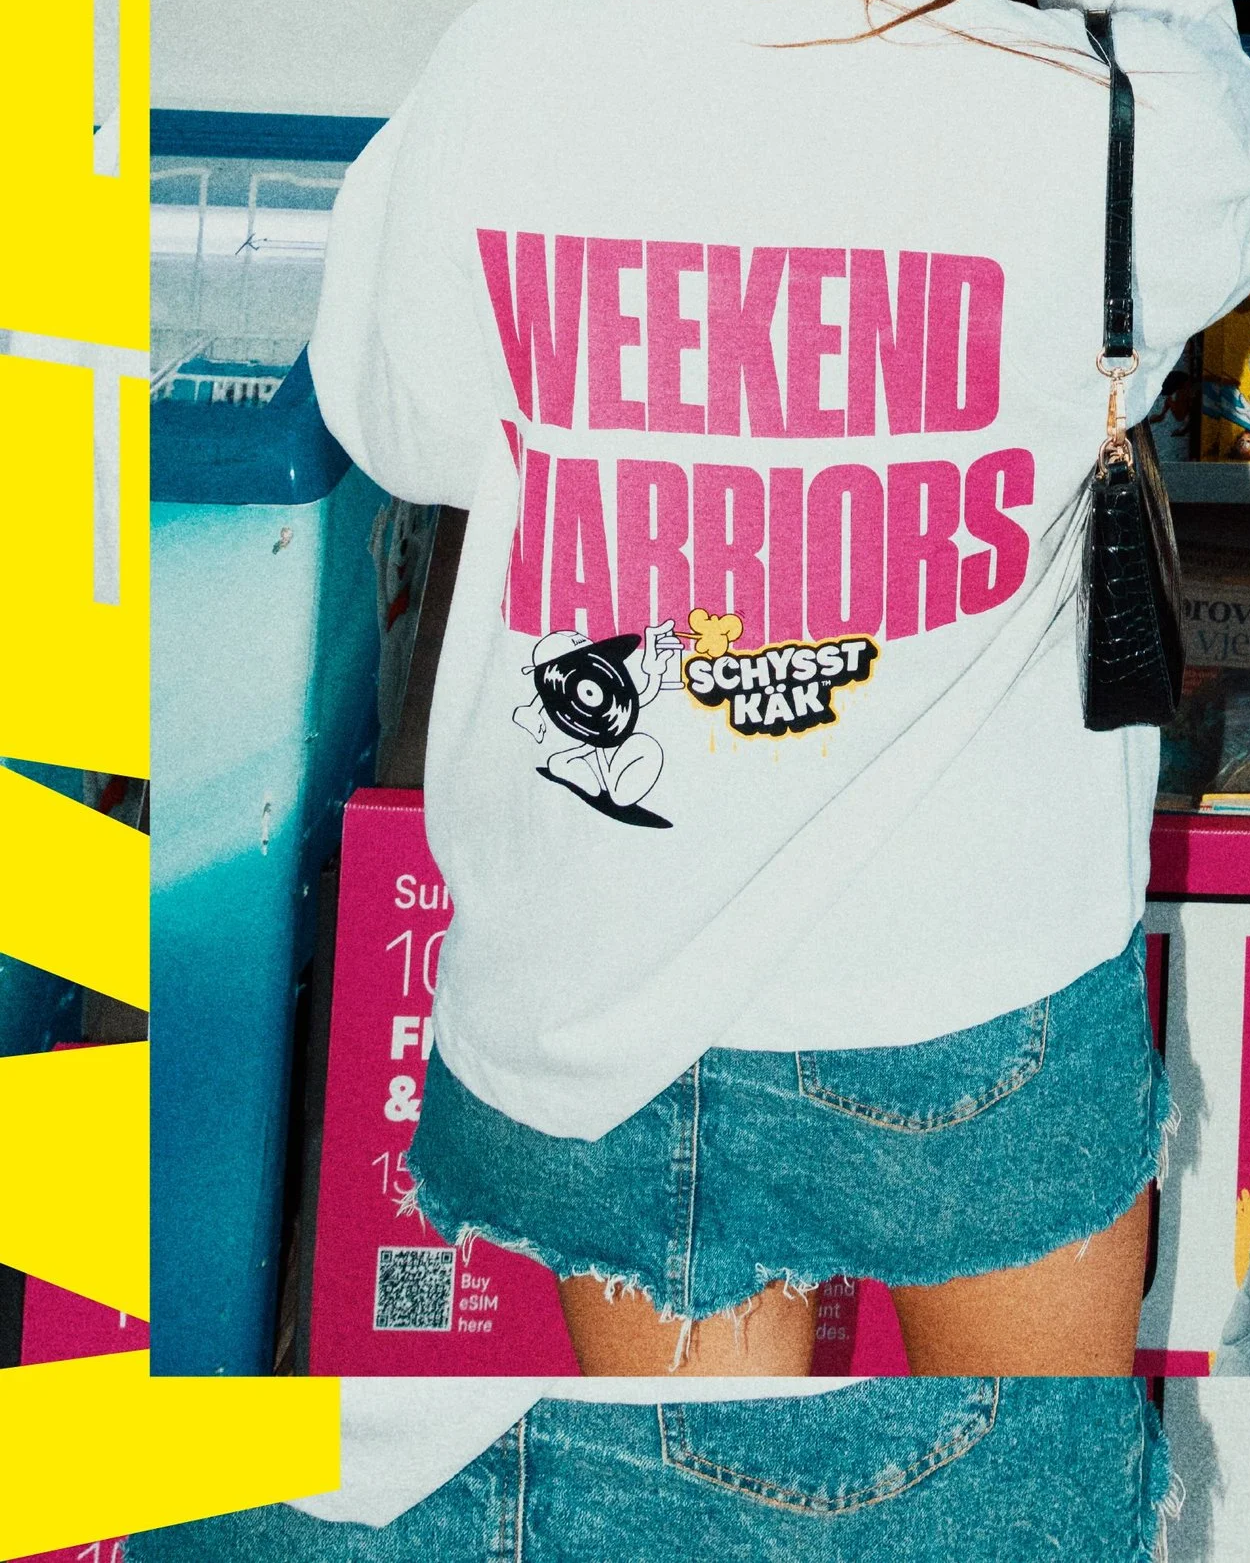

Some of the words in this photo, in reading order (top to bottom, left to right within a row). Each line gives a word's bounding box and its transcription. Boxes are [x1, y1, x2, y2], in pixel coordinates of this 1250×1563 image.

[476, 228, 1006, 439] WEEKEND
[690, 640, 870, 696] SCHYSST
[461, 1274, 490, 1295] Buy
[823, 1280, 855, 1296] and
[459, 1295, 499, 1313] eSIM
[458, 1316, 493, 1334] here
